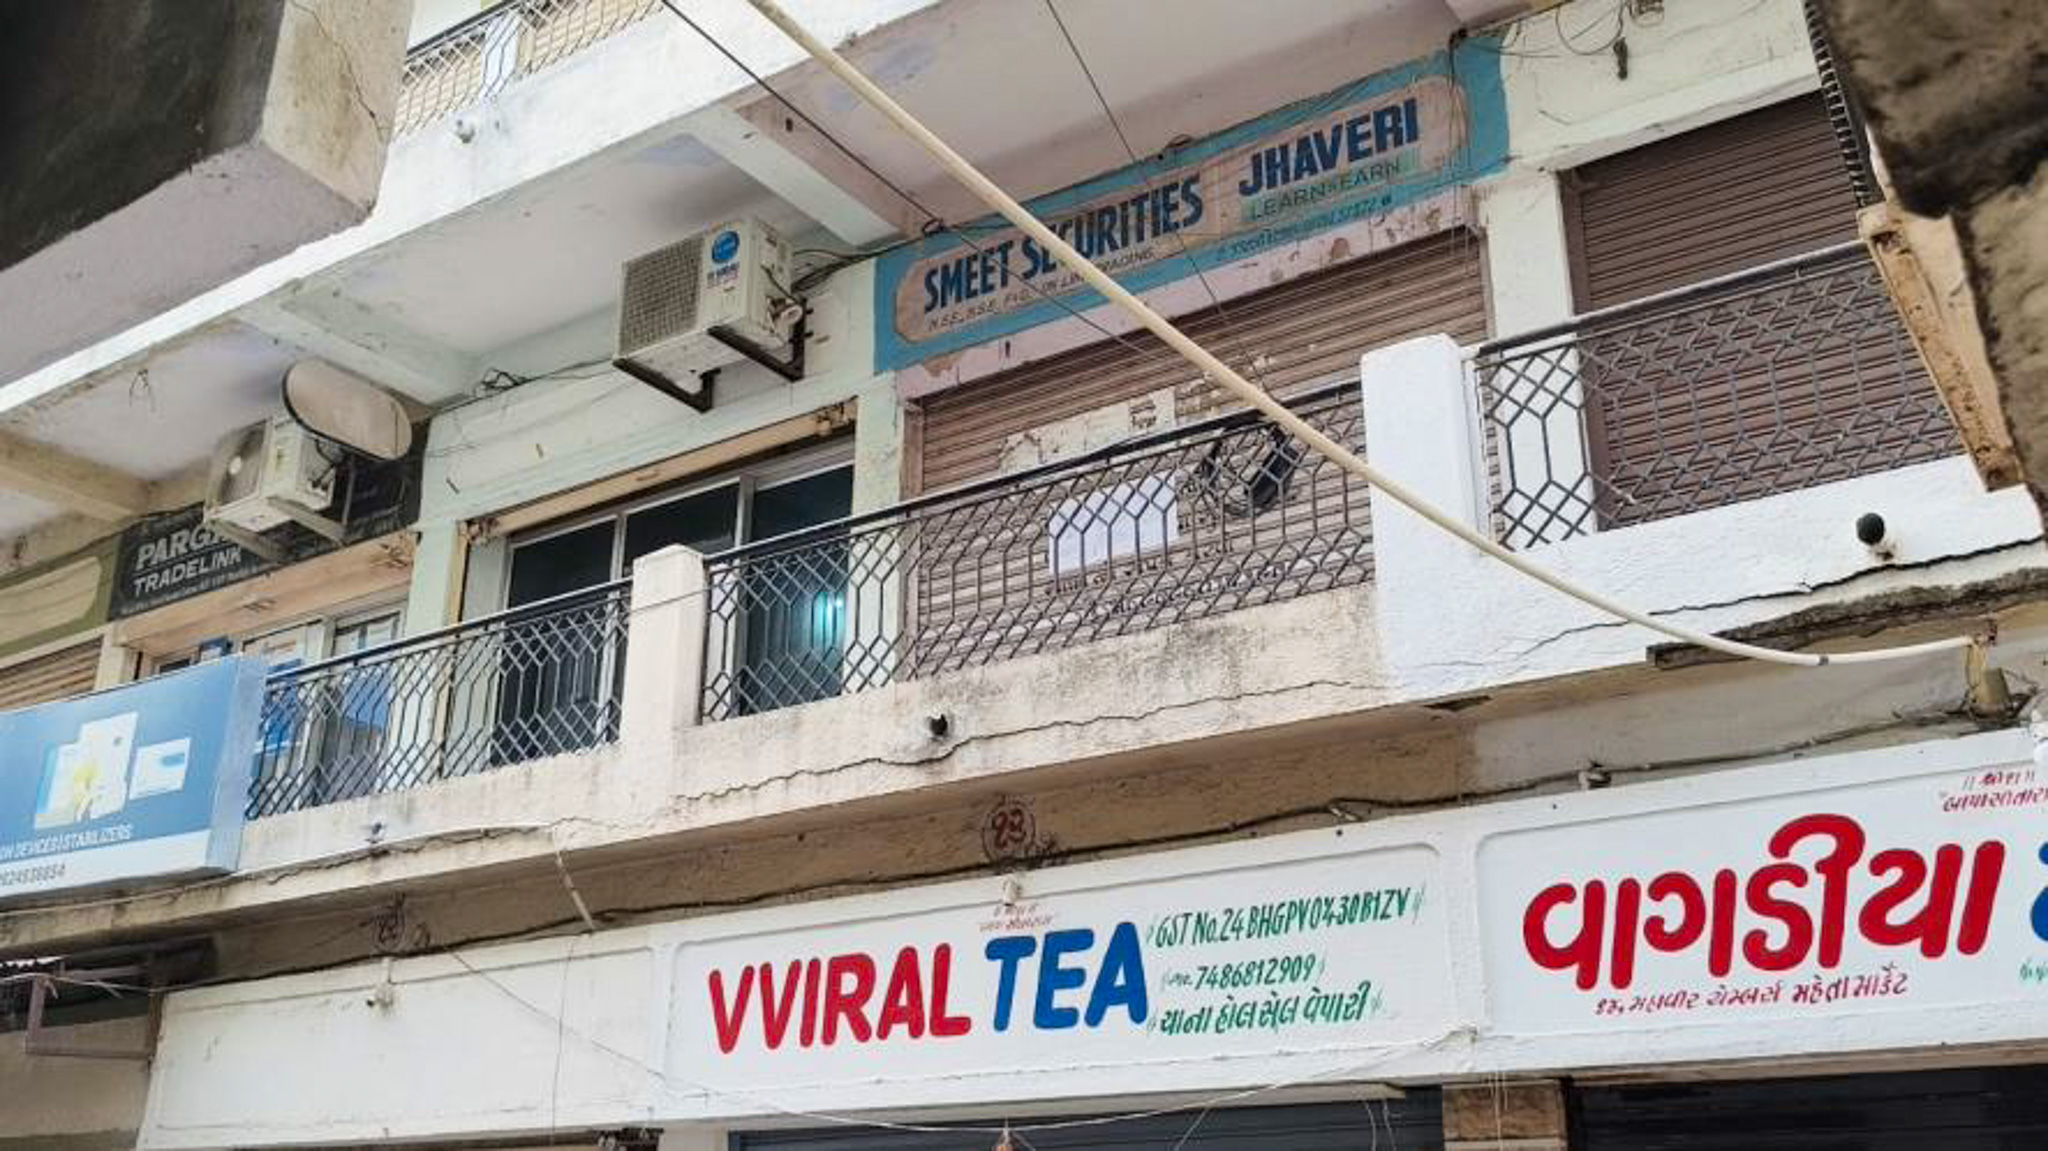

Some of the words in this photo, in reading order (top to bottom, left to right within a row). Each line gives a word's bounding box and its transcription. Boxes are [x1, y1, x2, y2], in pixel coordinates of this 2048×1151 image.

[924, 240, 1014, 313] SMEET
[1239, 98, 1418, 196] JHAVERI
[132, 547, 242, 598] TRADELINK
[1523, 813, 2005, 991] વાગડીયા
[1155, 911, 1193, 948] GST
[708, 942, 971, 1054] VVIRAL
[985, 921, 1148, 1031] TEA
[1194, 953, 1316, 990] 7486812909
[1792, 974, 1849, 1005] મહેતા
